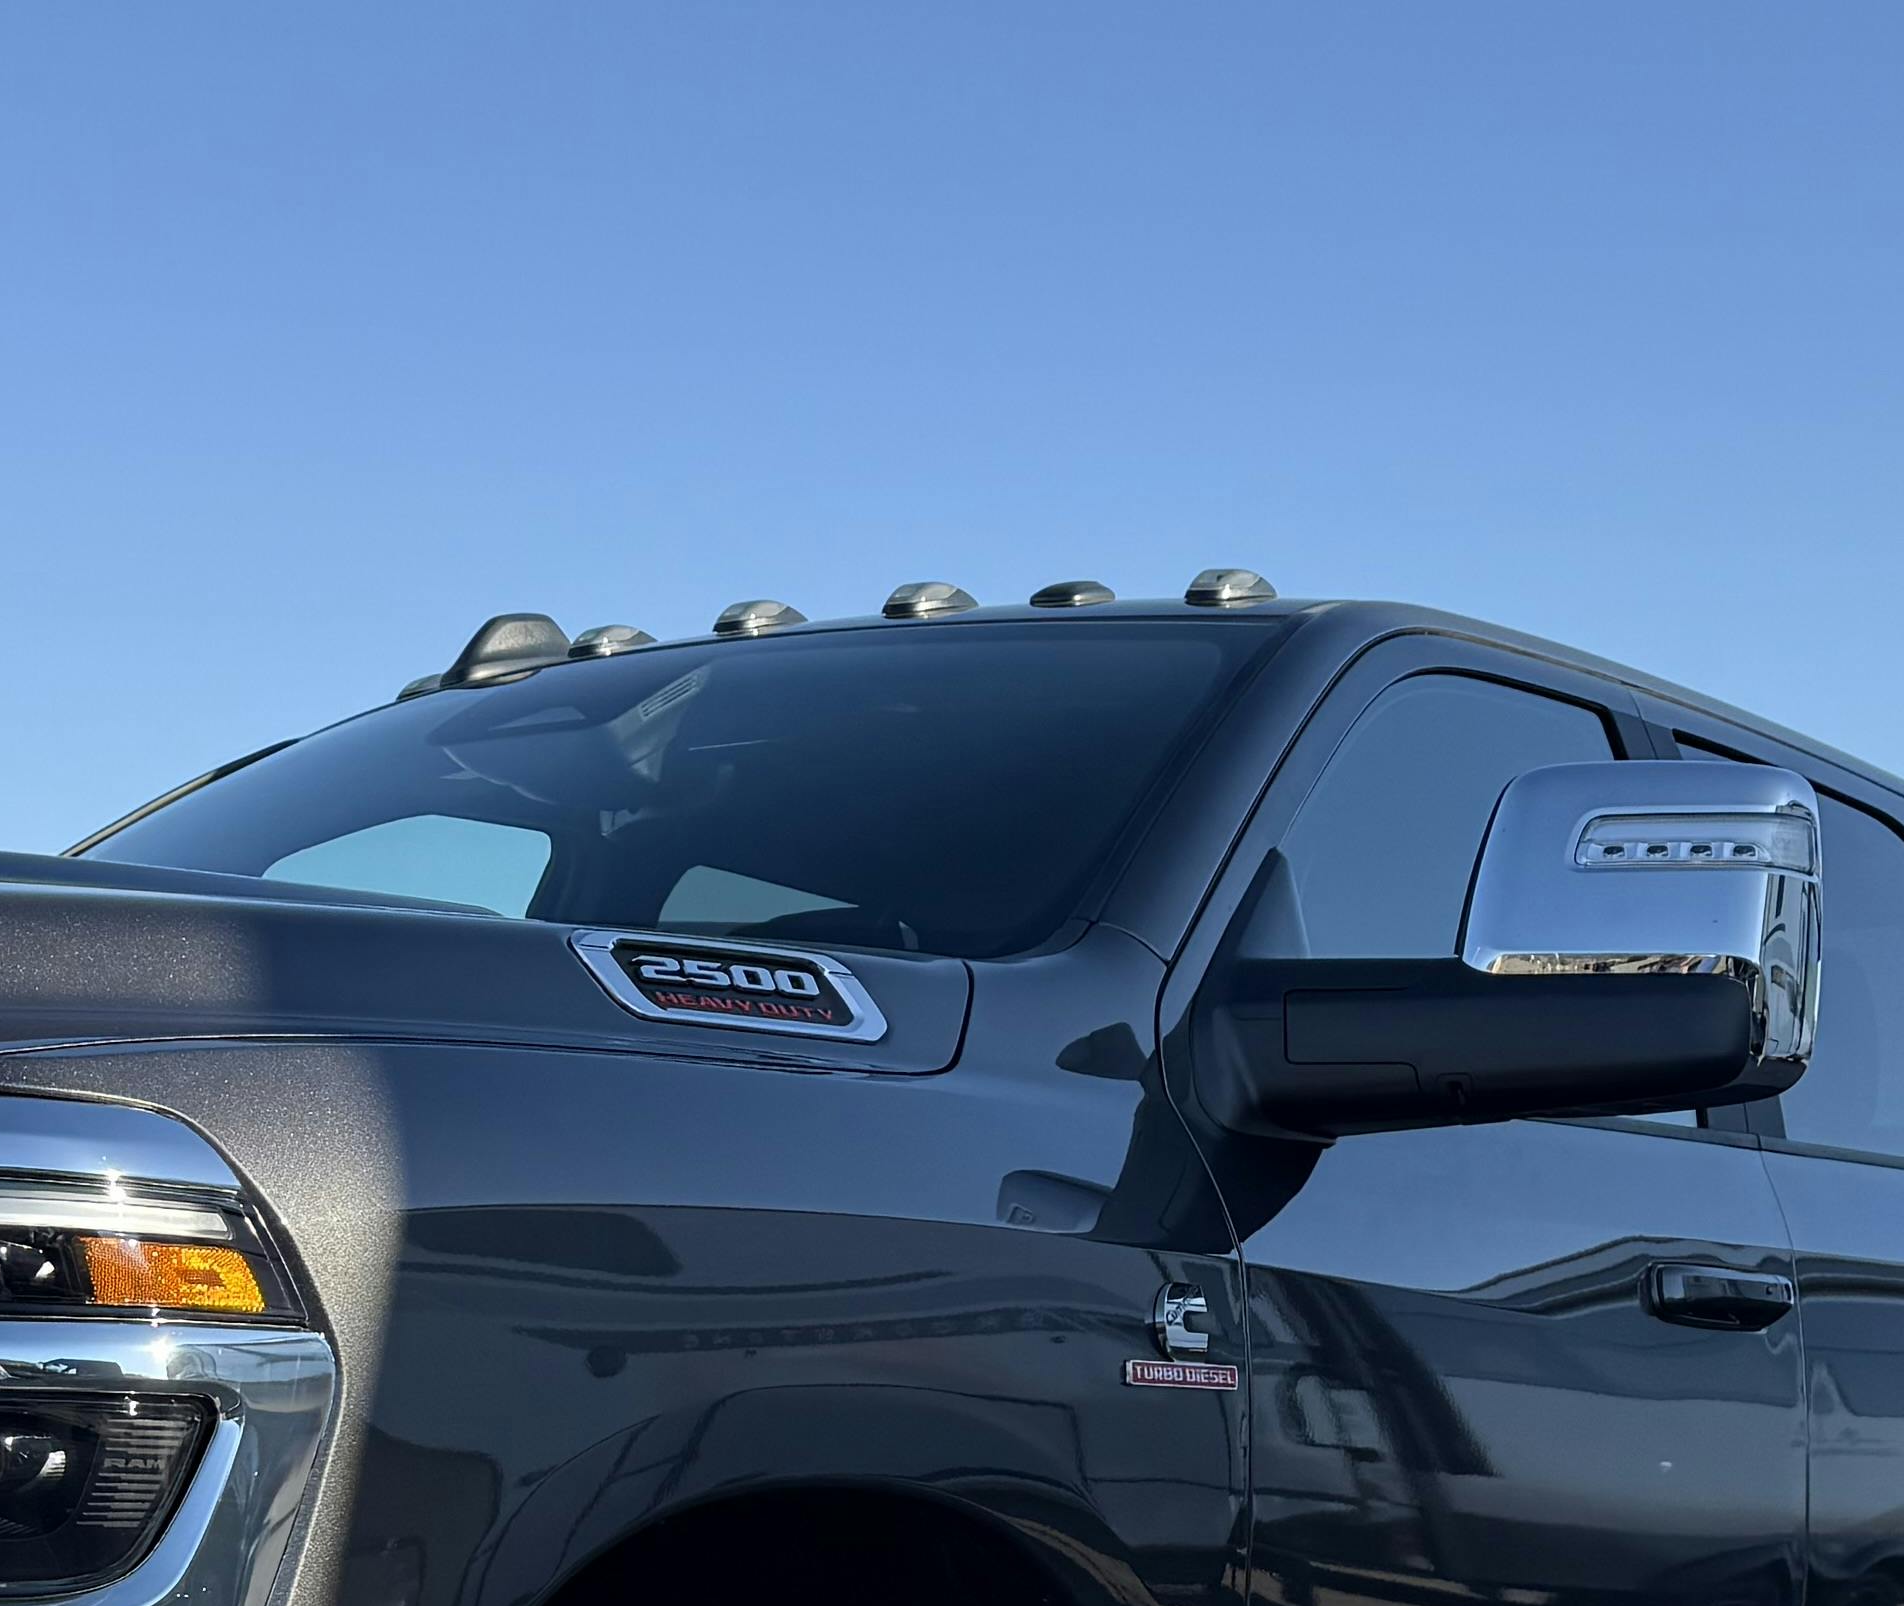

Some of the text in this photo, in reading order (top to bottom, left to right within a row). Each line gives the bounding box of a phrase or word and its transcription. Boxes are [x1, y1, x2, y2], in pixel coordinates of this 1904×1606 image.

[631, 954, 821, 996] 2500
[655, 990, 833, 1021] HEAVY DUTY
[1134, 1364, 1236, 1385] TURBO DIESEL
[104, 1457, 166, 1471] RAM
